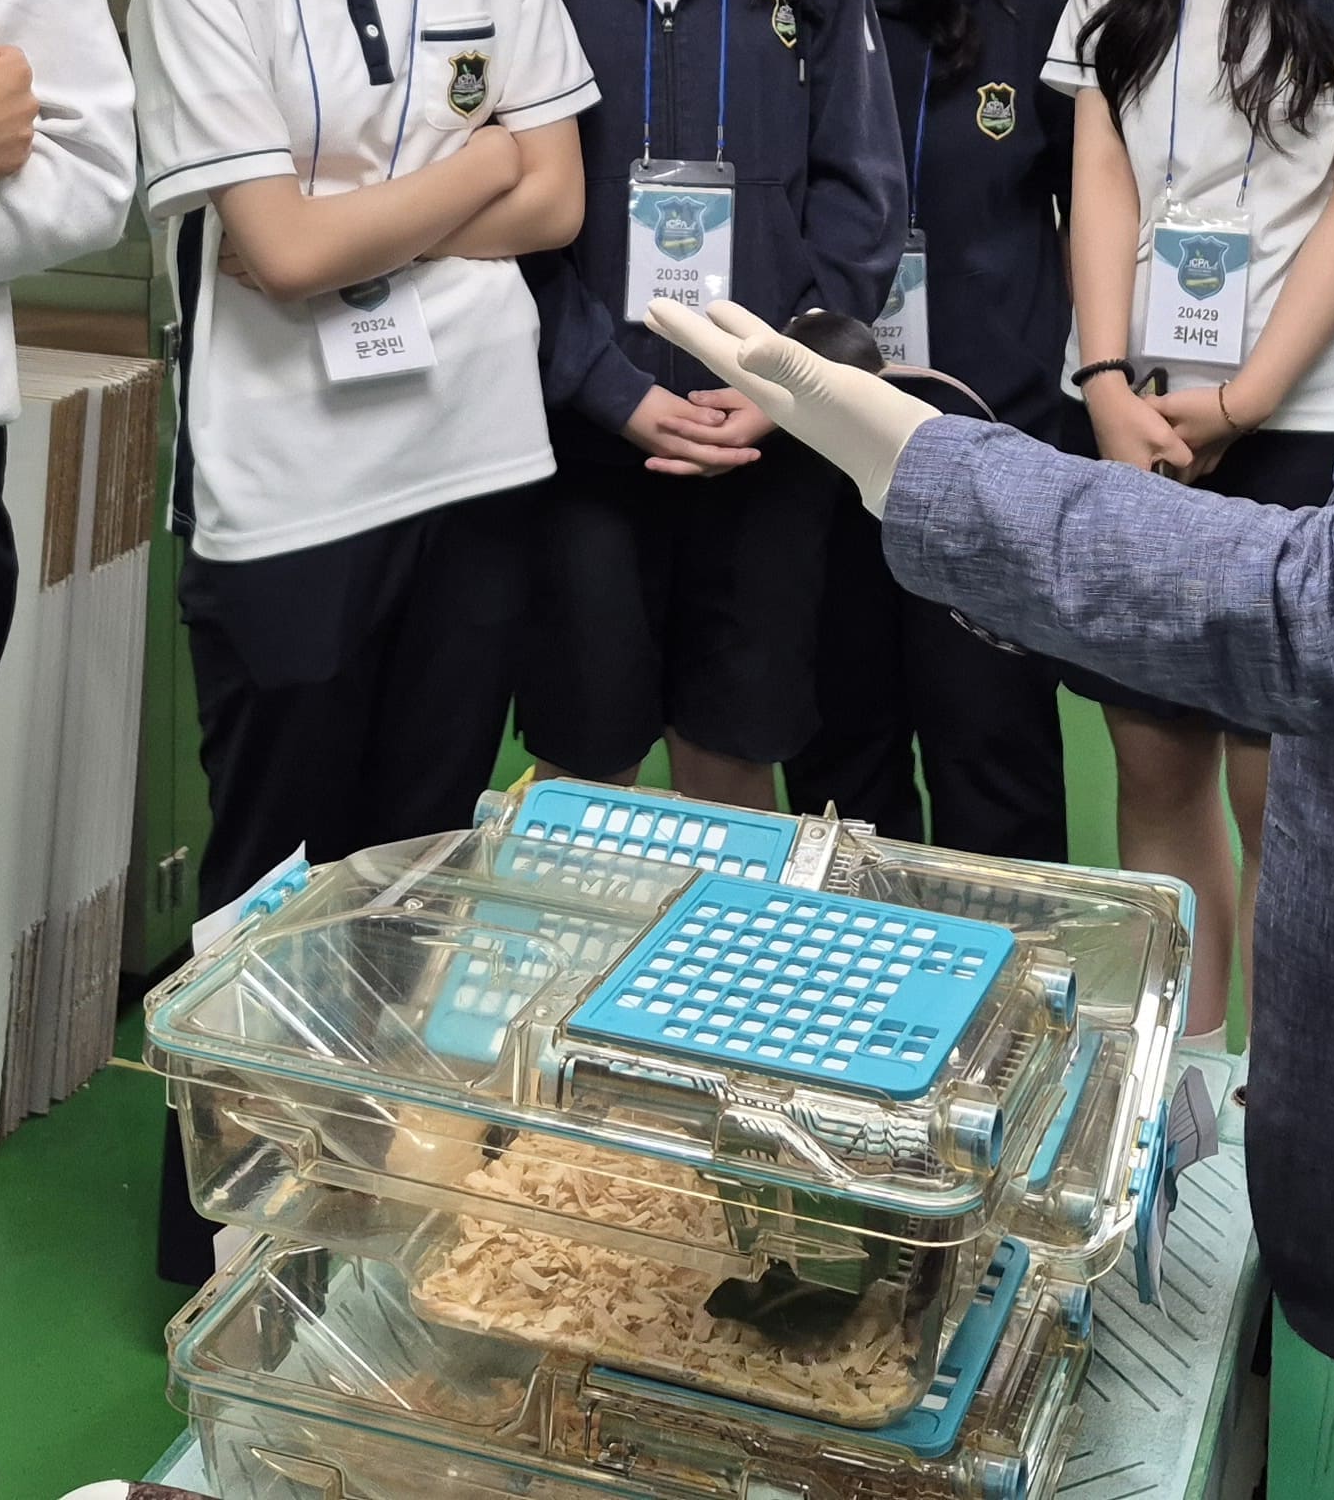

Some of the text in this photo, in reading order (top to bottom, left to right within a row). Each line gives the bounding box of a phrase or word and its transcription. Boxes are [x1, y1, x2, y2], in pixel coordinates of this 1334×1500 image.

[656, 267, 699, 282] 20330
[1177, 305, 1219, 322] 20429
[351, 317, 397, 335] 20324
[872, 325, 903, 338] 0327
[1172, 325, 1219, 348] 최서연
[355, 335, 406, 360] 문정민
